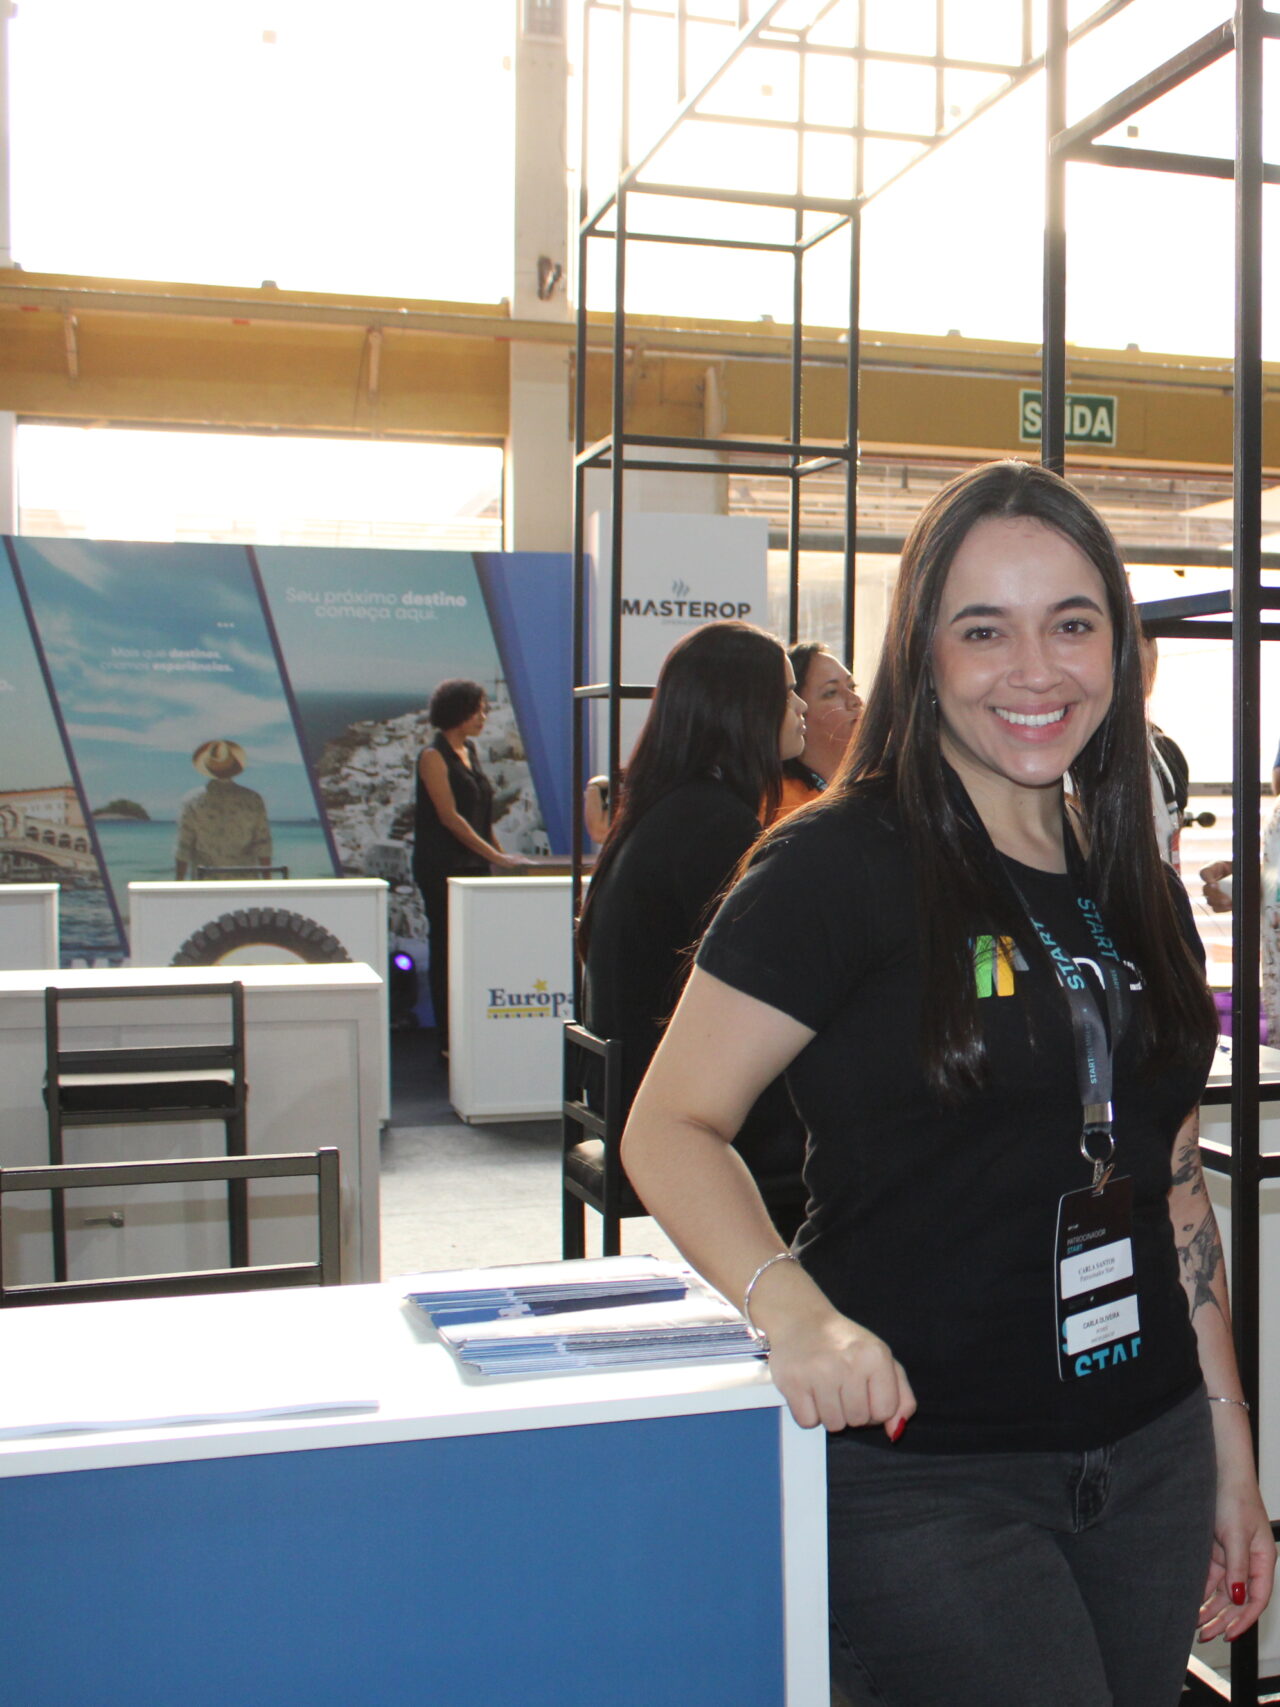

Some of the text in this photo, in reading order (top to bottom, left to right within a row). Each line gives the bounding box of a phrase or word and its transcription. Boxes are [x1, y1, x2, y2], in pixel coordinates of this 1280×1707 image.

[1024, 398, 1112, 437] SÍDA
[285, 587, 467, 607] Seu próximo destino
[314, 604, 391, 622] começa
[621, 598, 751, 619] MASTEROP
[1077, 897, 1119, 962] START
[1083, 1319, 1098, 1329] CARLA
